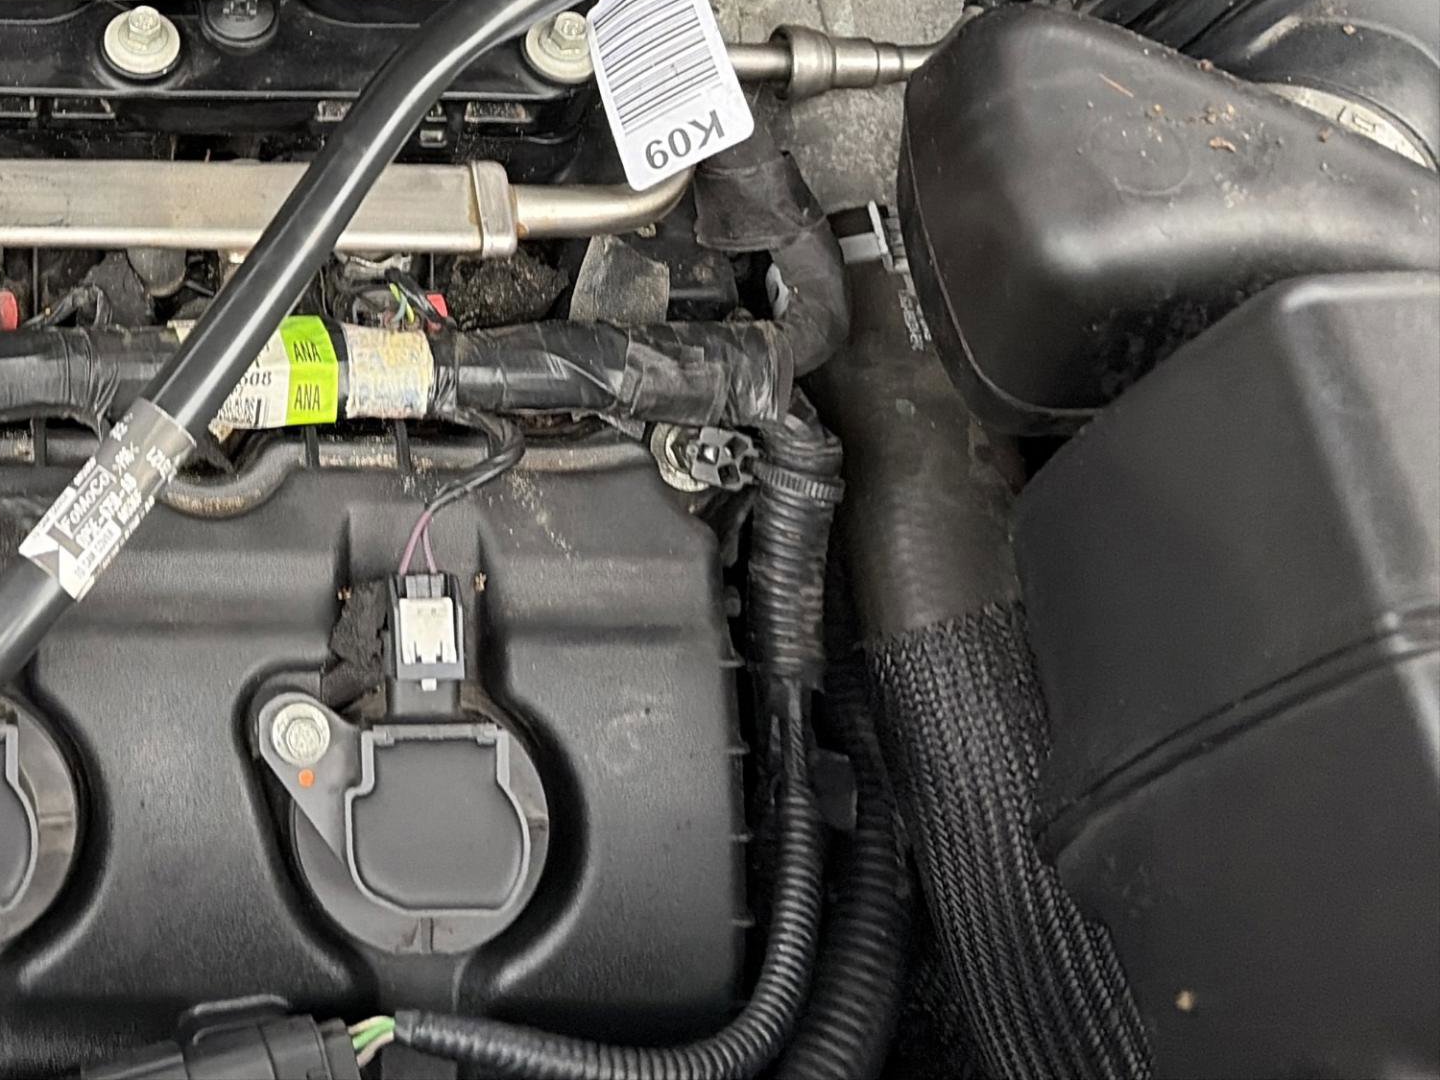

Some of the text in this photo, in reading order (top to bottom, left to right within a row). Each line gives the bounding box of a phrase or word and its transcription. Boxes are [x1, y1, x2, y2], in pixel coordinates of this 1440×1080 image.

[645, 110, 725, 169] K09
[294, 341, 321, 362] ANA
[294, 384, 320, 411] ANA
[58, 470, 113, 532] FoMoCo
